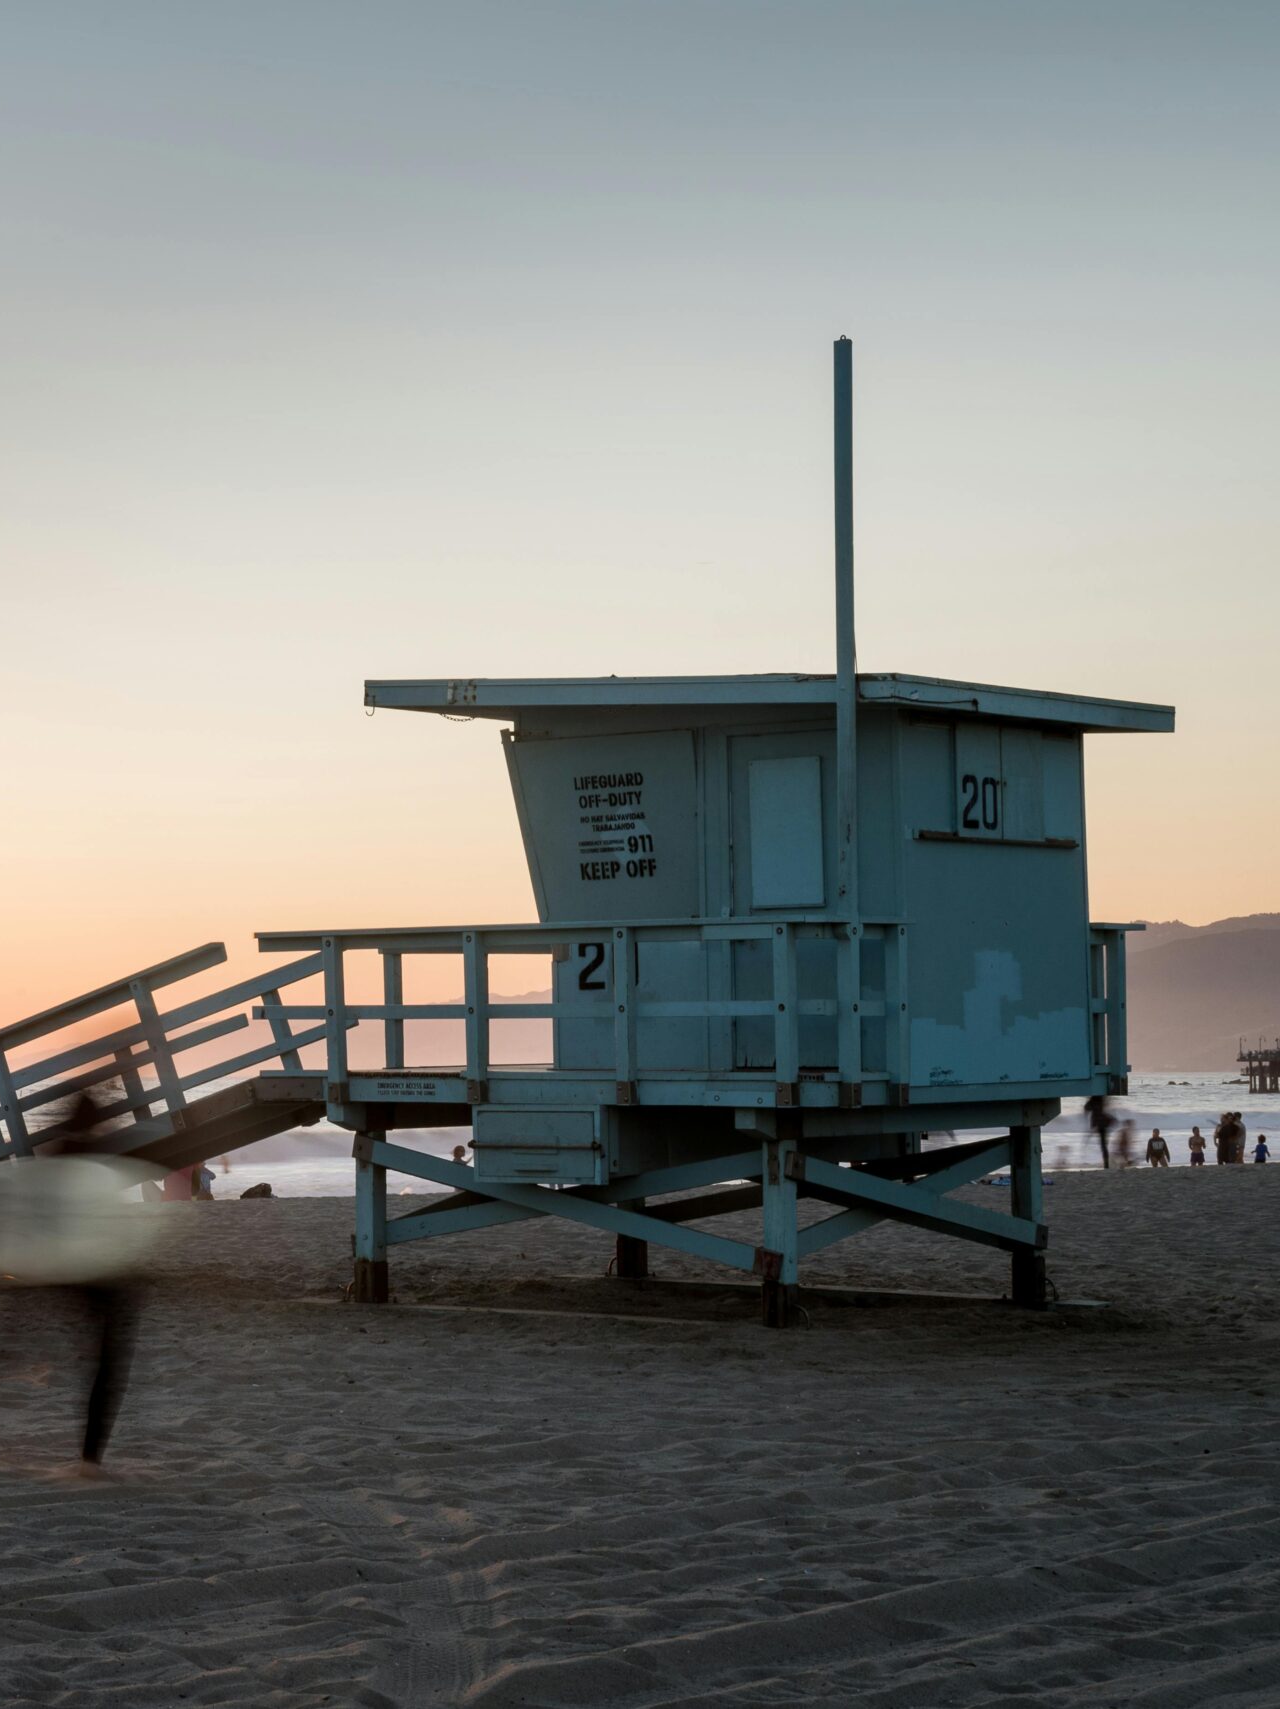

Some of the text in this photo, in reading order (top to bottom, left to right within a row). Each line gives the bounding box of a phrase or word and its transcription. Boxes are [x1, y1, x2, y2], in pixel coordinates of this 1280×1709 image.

[574, 772, 644, 791] LIFEGUARD
[578, 791, 642, 809] OFF-DUTY
[962, 774, 998, 830] 20
[580, 815, 590, 824] NO
[605, 812, 646, 822] SALVAVIDAS
[592, 822, 636, 832] TRABAJANDO
[627, 834, 654, 853] 911
[580, 858, 657, 881] KEEP OFF
[578, 942, 639, 990] 2
